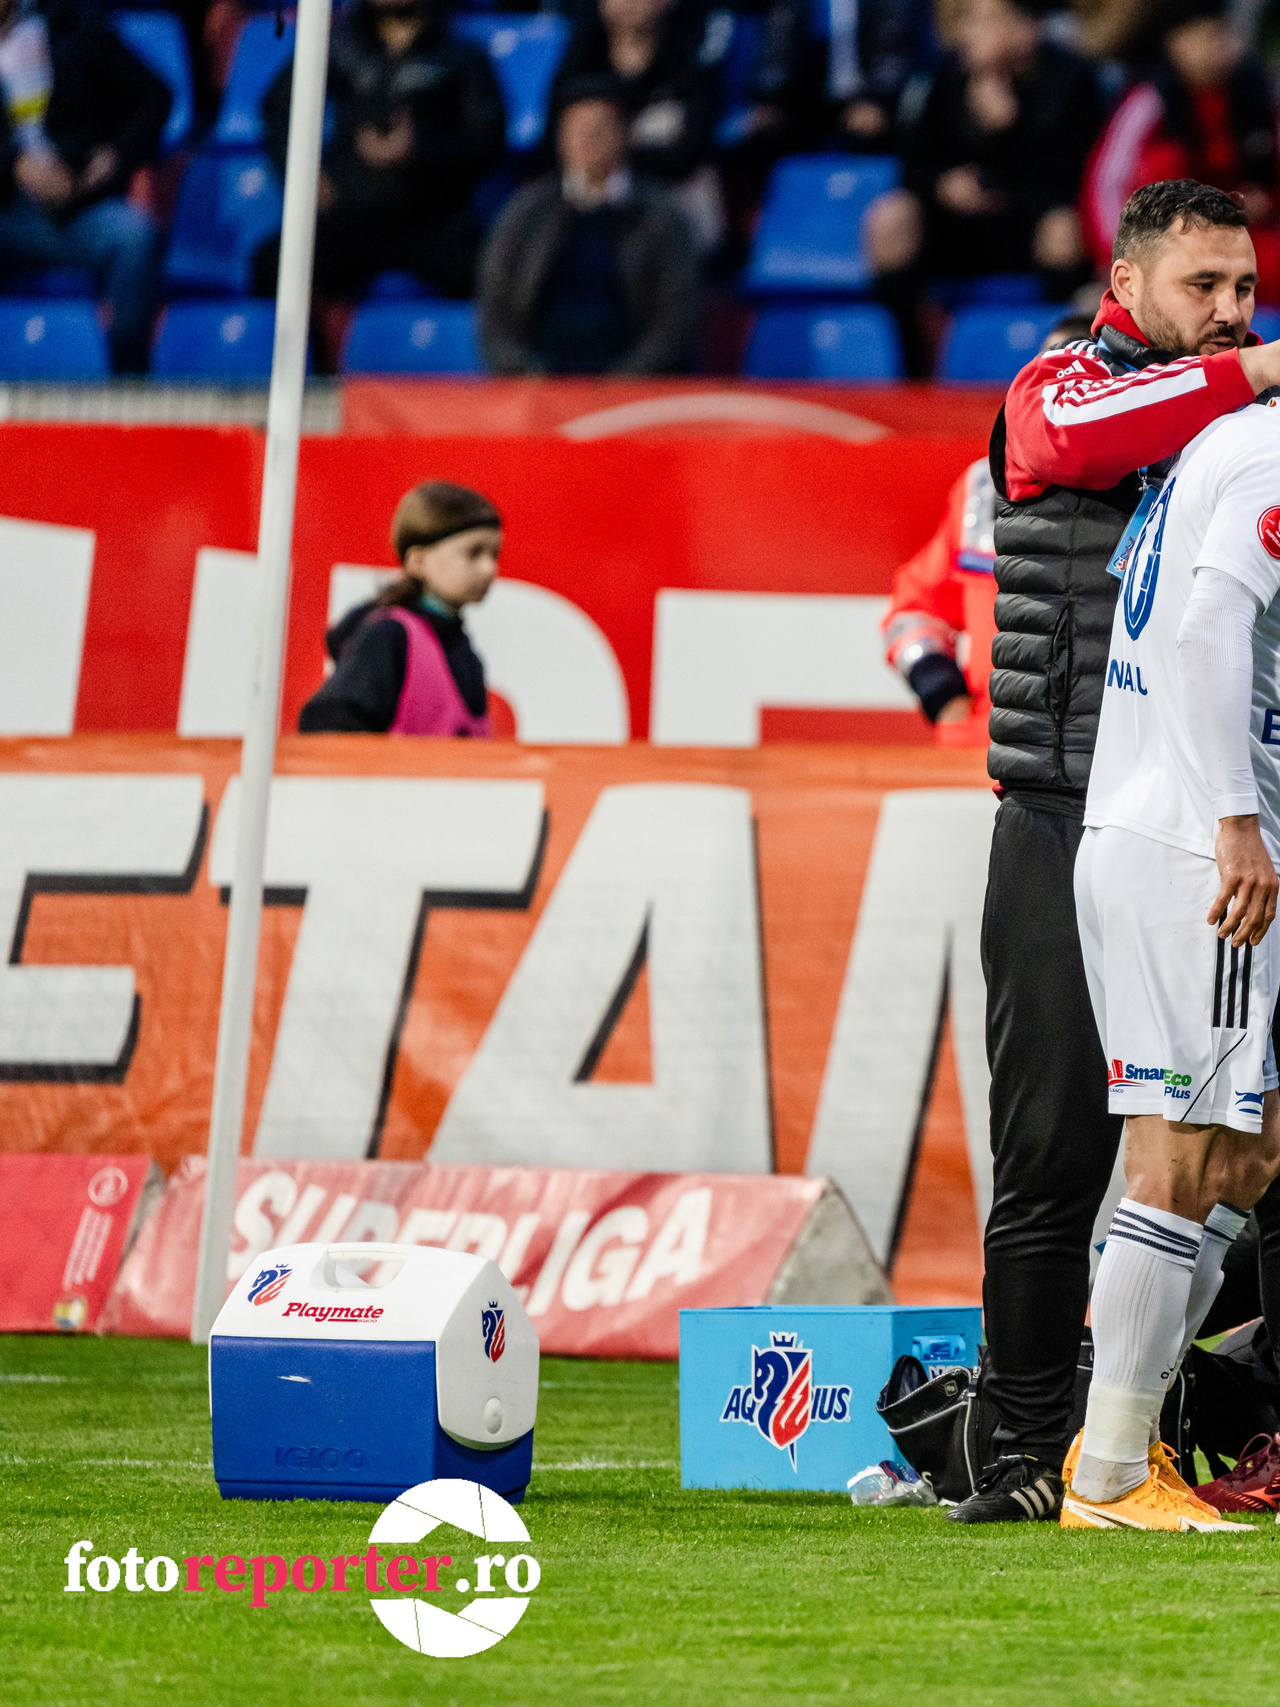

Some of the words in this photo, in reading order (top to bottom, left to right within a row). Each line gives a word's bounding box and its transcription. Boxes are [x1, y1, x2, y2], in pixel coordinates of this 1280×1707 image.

[1164, 1069, 1192, 1087] Eco
[1164, 1086, 1190, 1100] Plus
[282, 1302, 384, 1322] Playmate
